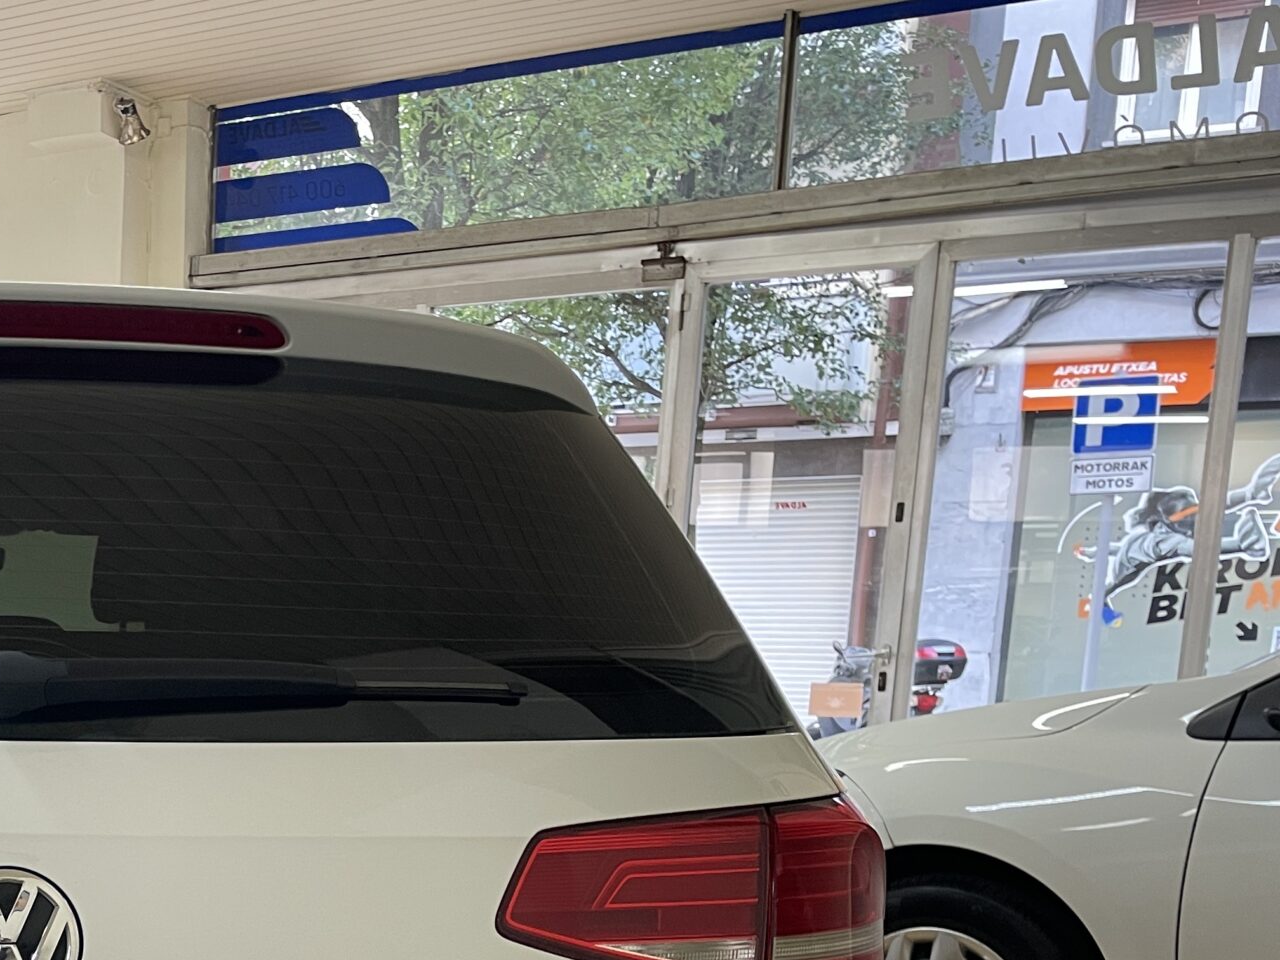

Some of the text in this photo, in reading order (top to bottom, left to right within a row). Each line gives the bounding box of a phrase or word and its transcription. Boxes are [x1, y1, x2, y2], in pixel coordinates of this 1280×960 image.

[1053, 361, 1157, 377] APUSTU ETXEA
[1085, 385, 1140, 447] P
[1073, 461, 1149, 474] MOTORRAK
[1085, 477, 1134, 489] MOTOS
